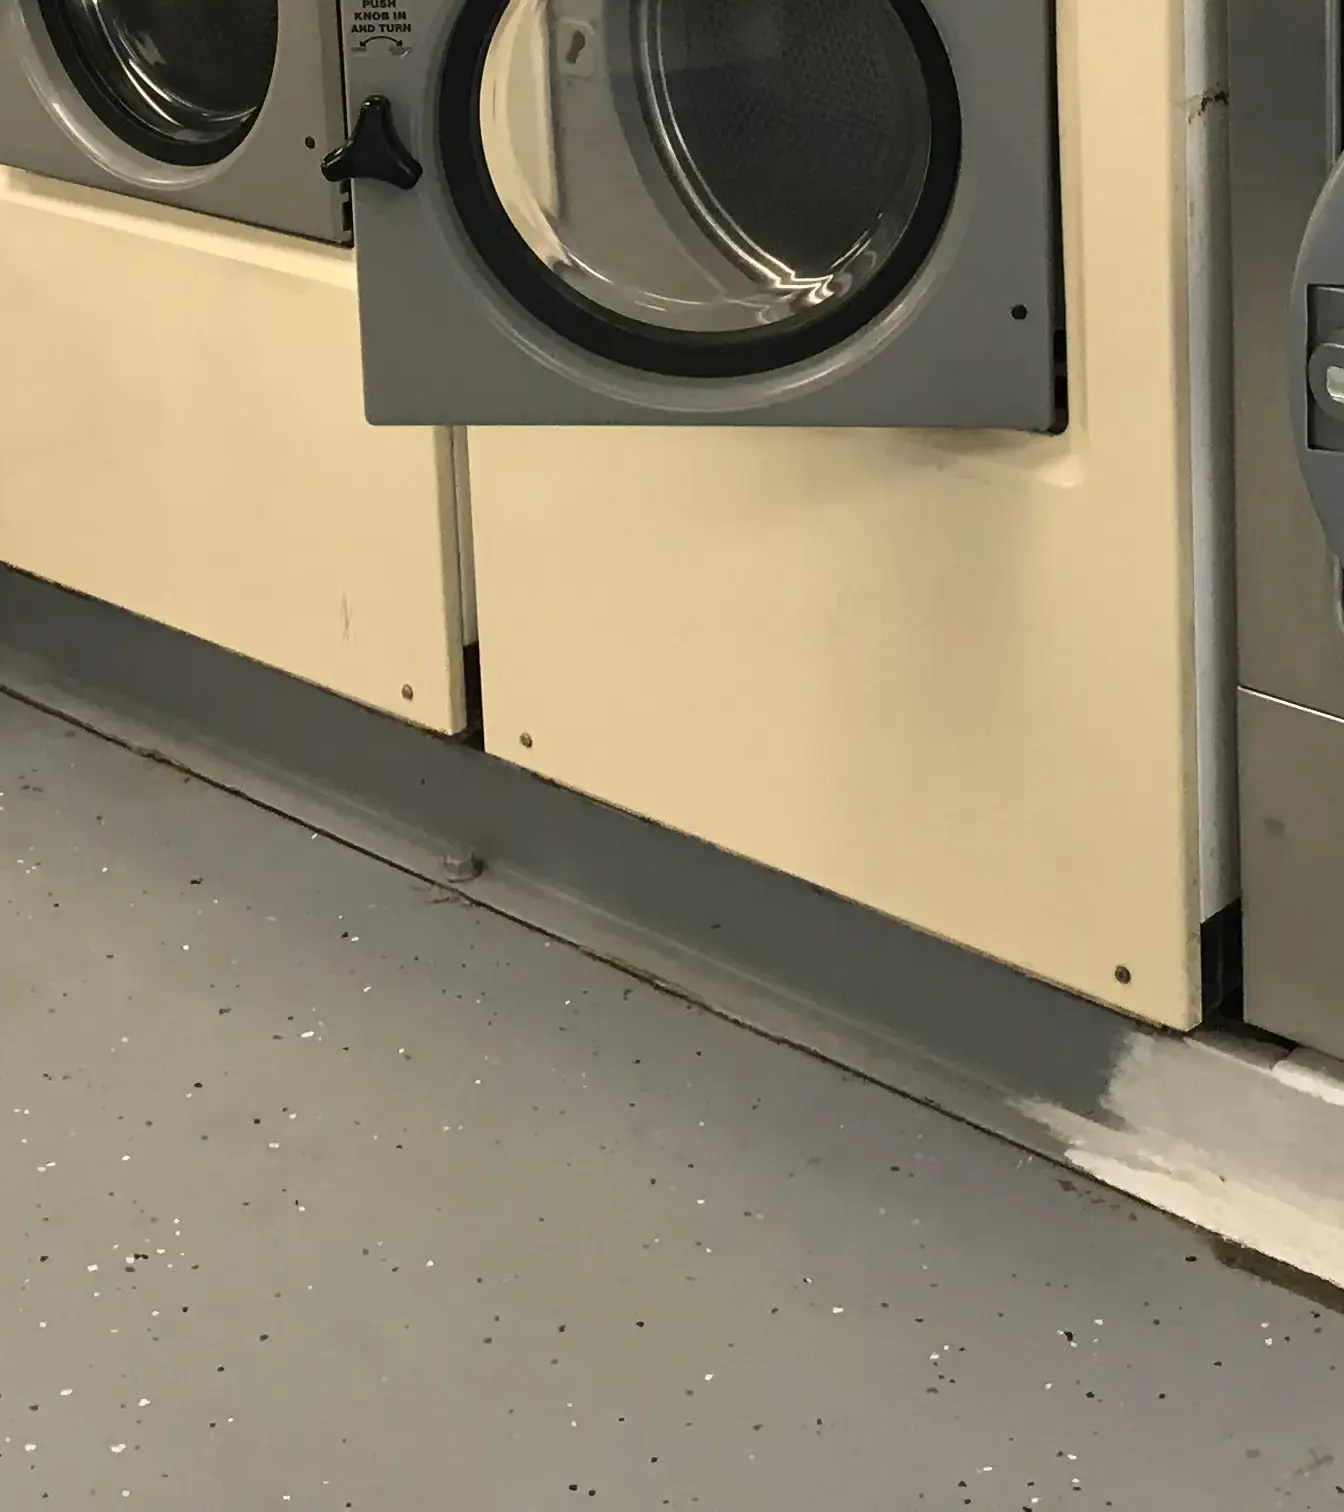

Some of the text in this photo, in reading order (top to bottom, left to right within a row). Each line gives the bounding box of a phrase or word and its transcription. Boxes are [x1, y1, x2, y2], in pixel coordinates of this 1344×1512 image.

[362, 0, 396, 8] PUSH
[354, 11, 407, 20] KNOB IN
[351, 23, 412, 33] AND TURN
